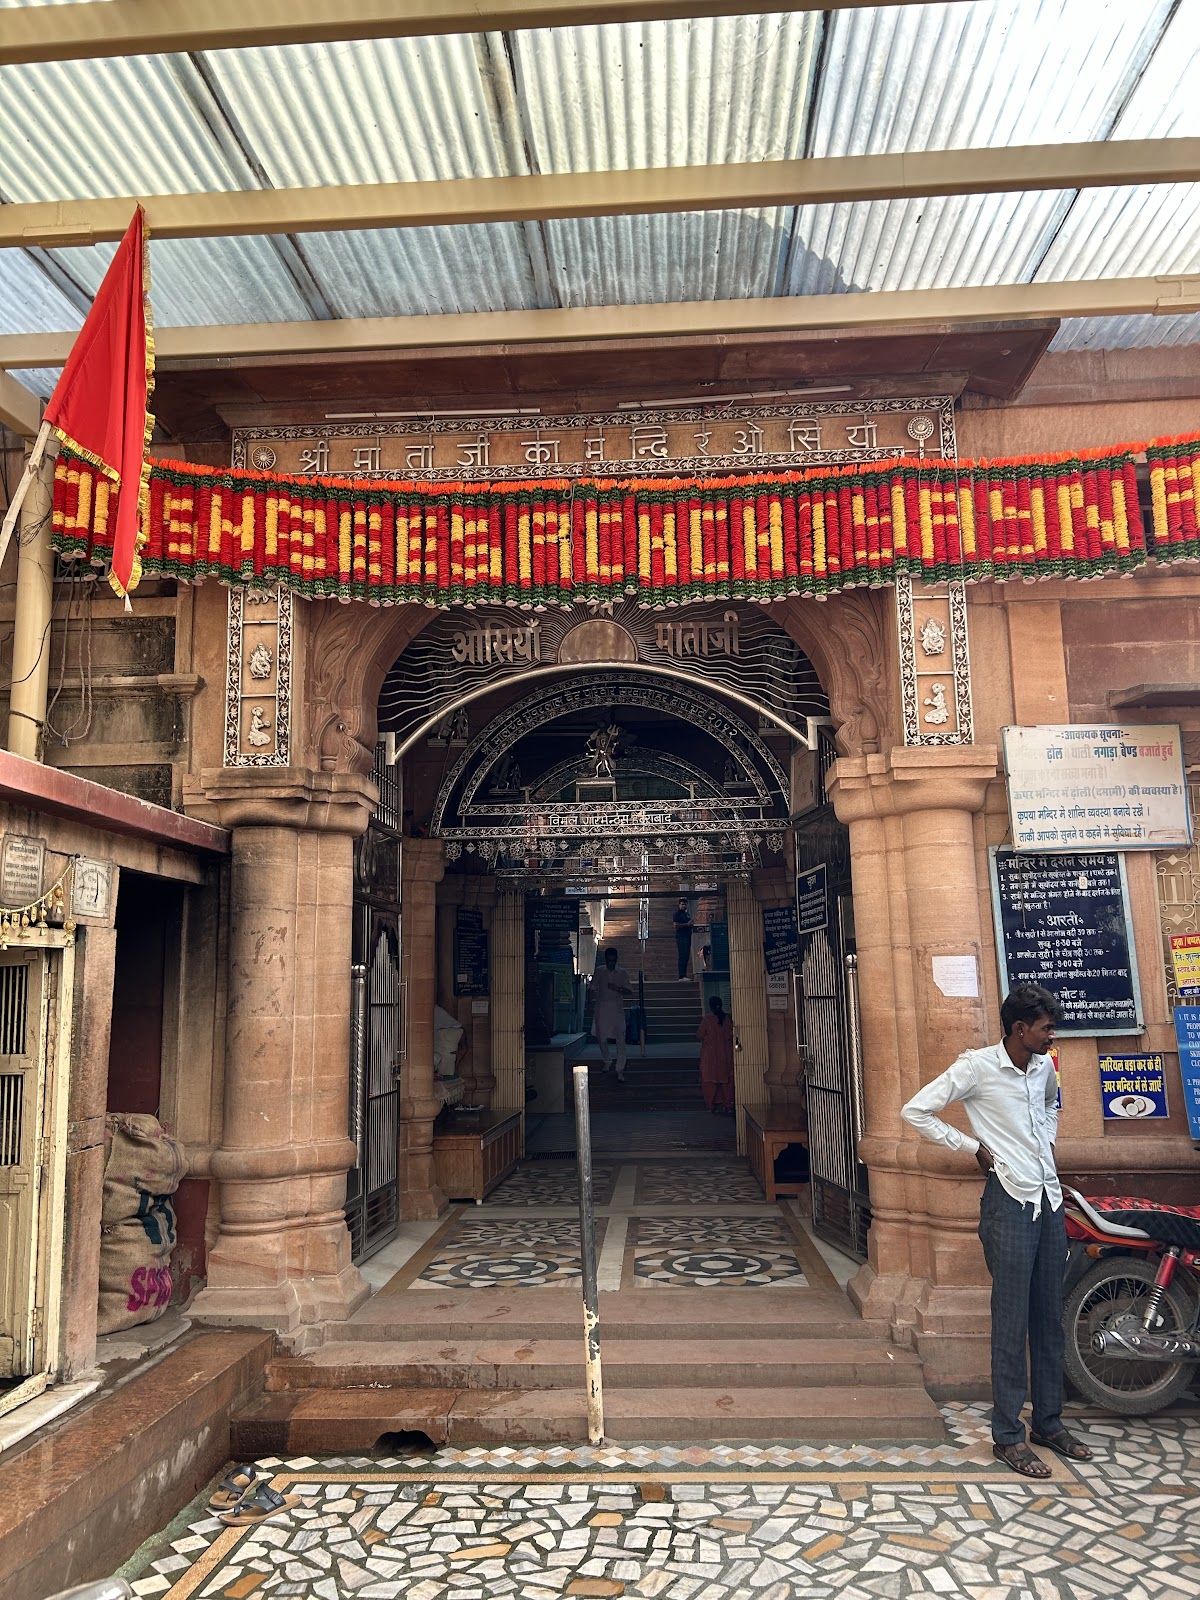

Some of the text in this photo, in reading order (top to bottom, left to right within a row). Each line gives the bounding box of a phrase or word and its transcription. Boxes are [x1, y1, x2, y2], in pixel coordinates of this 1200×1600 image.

[299, 438, 330, 472] श्री
[520, 439, 560, 464] का
[584, 424, 713, 461] मन्दिर
[655, 610, 741, 658] माताजी
[1128, 784, 1141, 796] की
[1142, 785, 1171, 796] व्यवस्था
[548, 813, 578, 826] विमल
[1017, 810, 1036, 825] कृपया
[1037, 807, 1058, 820] मन्दिर
[1067, 804, 1086, 819] शान्ति
[1087, 807, 1112, 819] व्यवस्था
[1112, 803, 1131, 818] बनाये
[1019, 830, 1035, 842] ताकी
[1036, 826, 1059, 842] आपको
[1060, 826, 1078, 844] सुनने
[1079, 829, 1085, 840] व
[1103, 825, 1111, 839] में
[1007, 856, 1038, 870] मन्दिर
[1038, 855, 1048, 868] में
[1078, 855, 1106, 868] समय
[1046, 910, 1079, 927] आरती
[1060, 986, 1078, 1000] नोट
[1187, 1031, 1195, 1039] TO
[1100, 1056, 1124, 1072] नारियल
[1136, 1059, 1147, 1072] कर
[1147, 1056, 1154, 1072] के
[1154, 1056, 1162, 1072] ही
[1103, 1080, 1116, 1093] उपर
[1116, 1076, 1134, 1093] मन्दिर
[1141, 1075, 1148, 1092] ले
